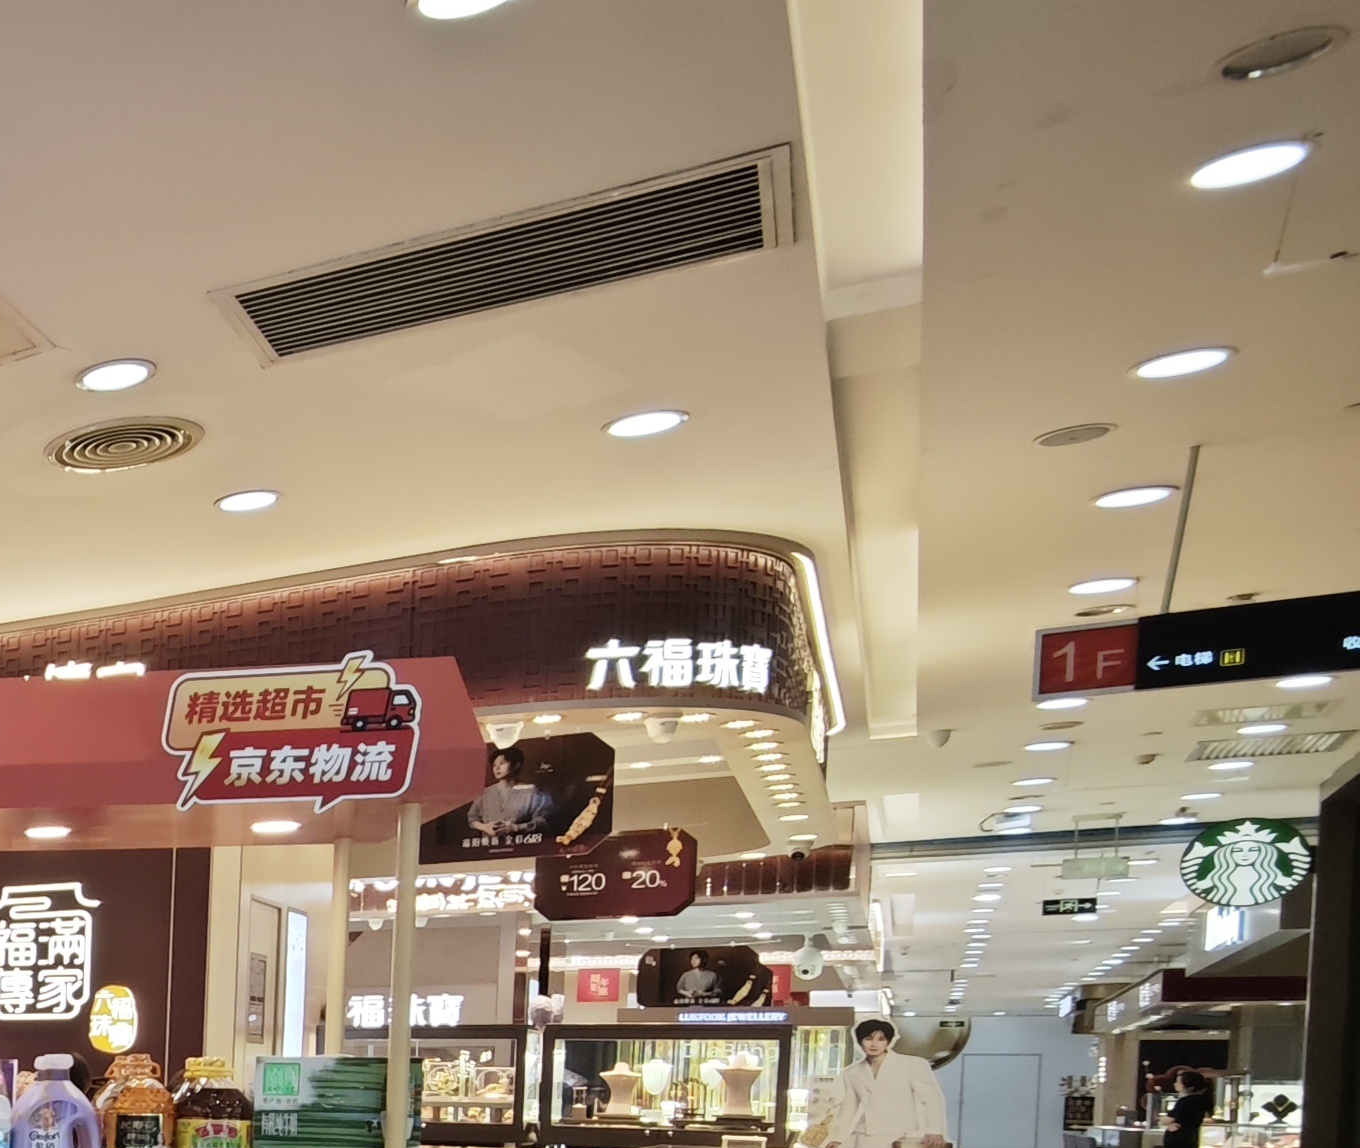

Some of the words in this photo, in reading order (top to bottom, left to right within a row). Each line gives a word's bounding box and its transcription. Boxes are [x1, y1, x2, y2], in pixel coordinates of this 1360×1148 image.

[584, 636, 774, 694] 六福珠寶
[1174, 651, 1213, 667] 电梯
[185, 685, 326, 725] 精选超市
[223, 741, 396, 787] 京东物流
[29, 1131, 60, 1142] Comfort
